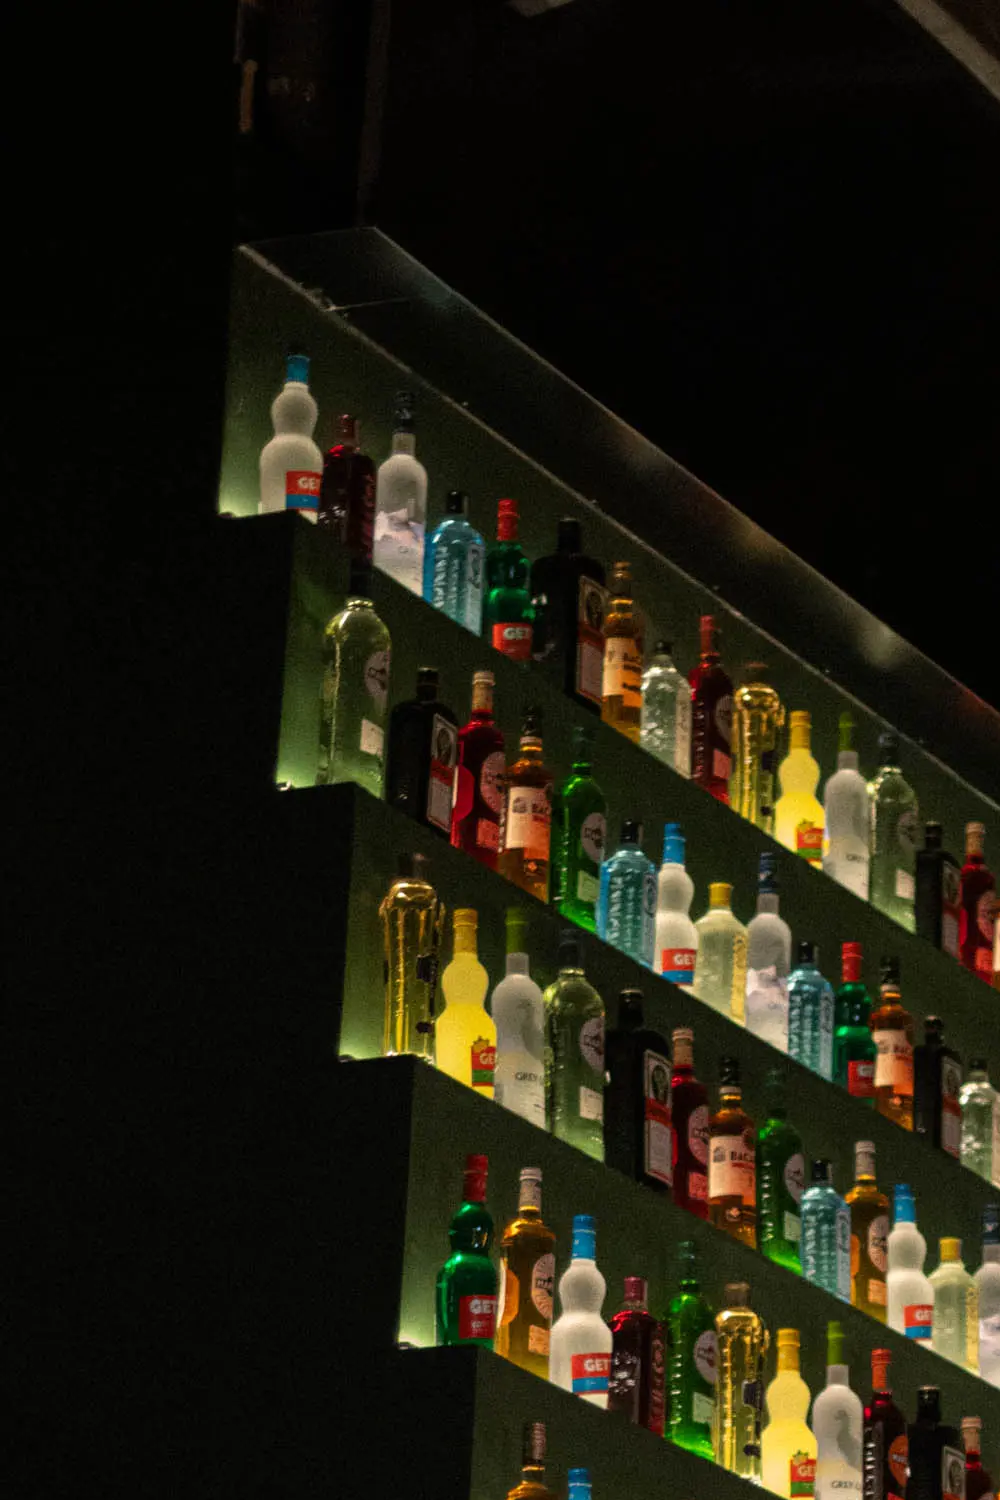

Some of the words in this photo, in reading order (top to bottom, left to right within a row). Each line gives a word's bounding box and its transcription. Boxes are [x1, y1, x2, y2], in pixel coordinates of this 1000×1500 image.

[297, 476, 321, 490] GE
[672, 953, 695, 966] GE
[479, 1053, 495, 1065] GE
[914, 1309, 932, 1321] GE
